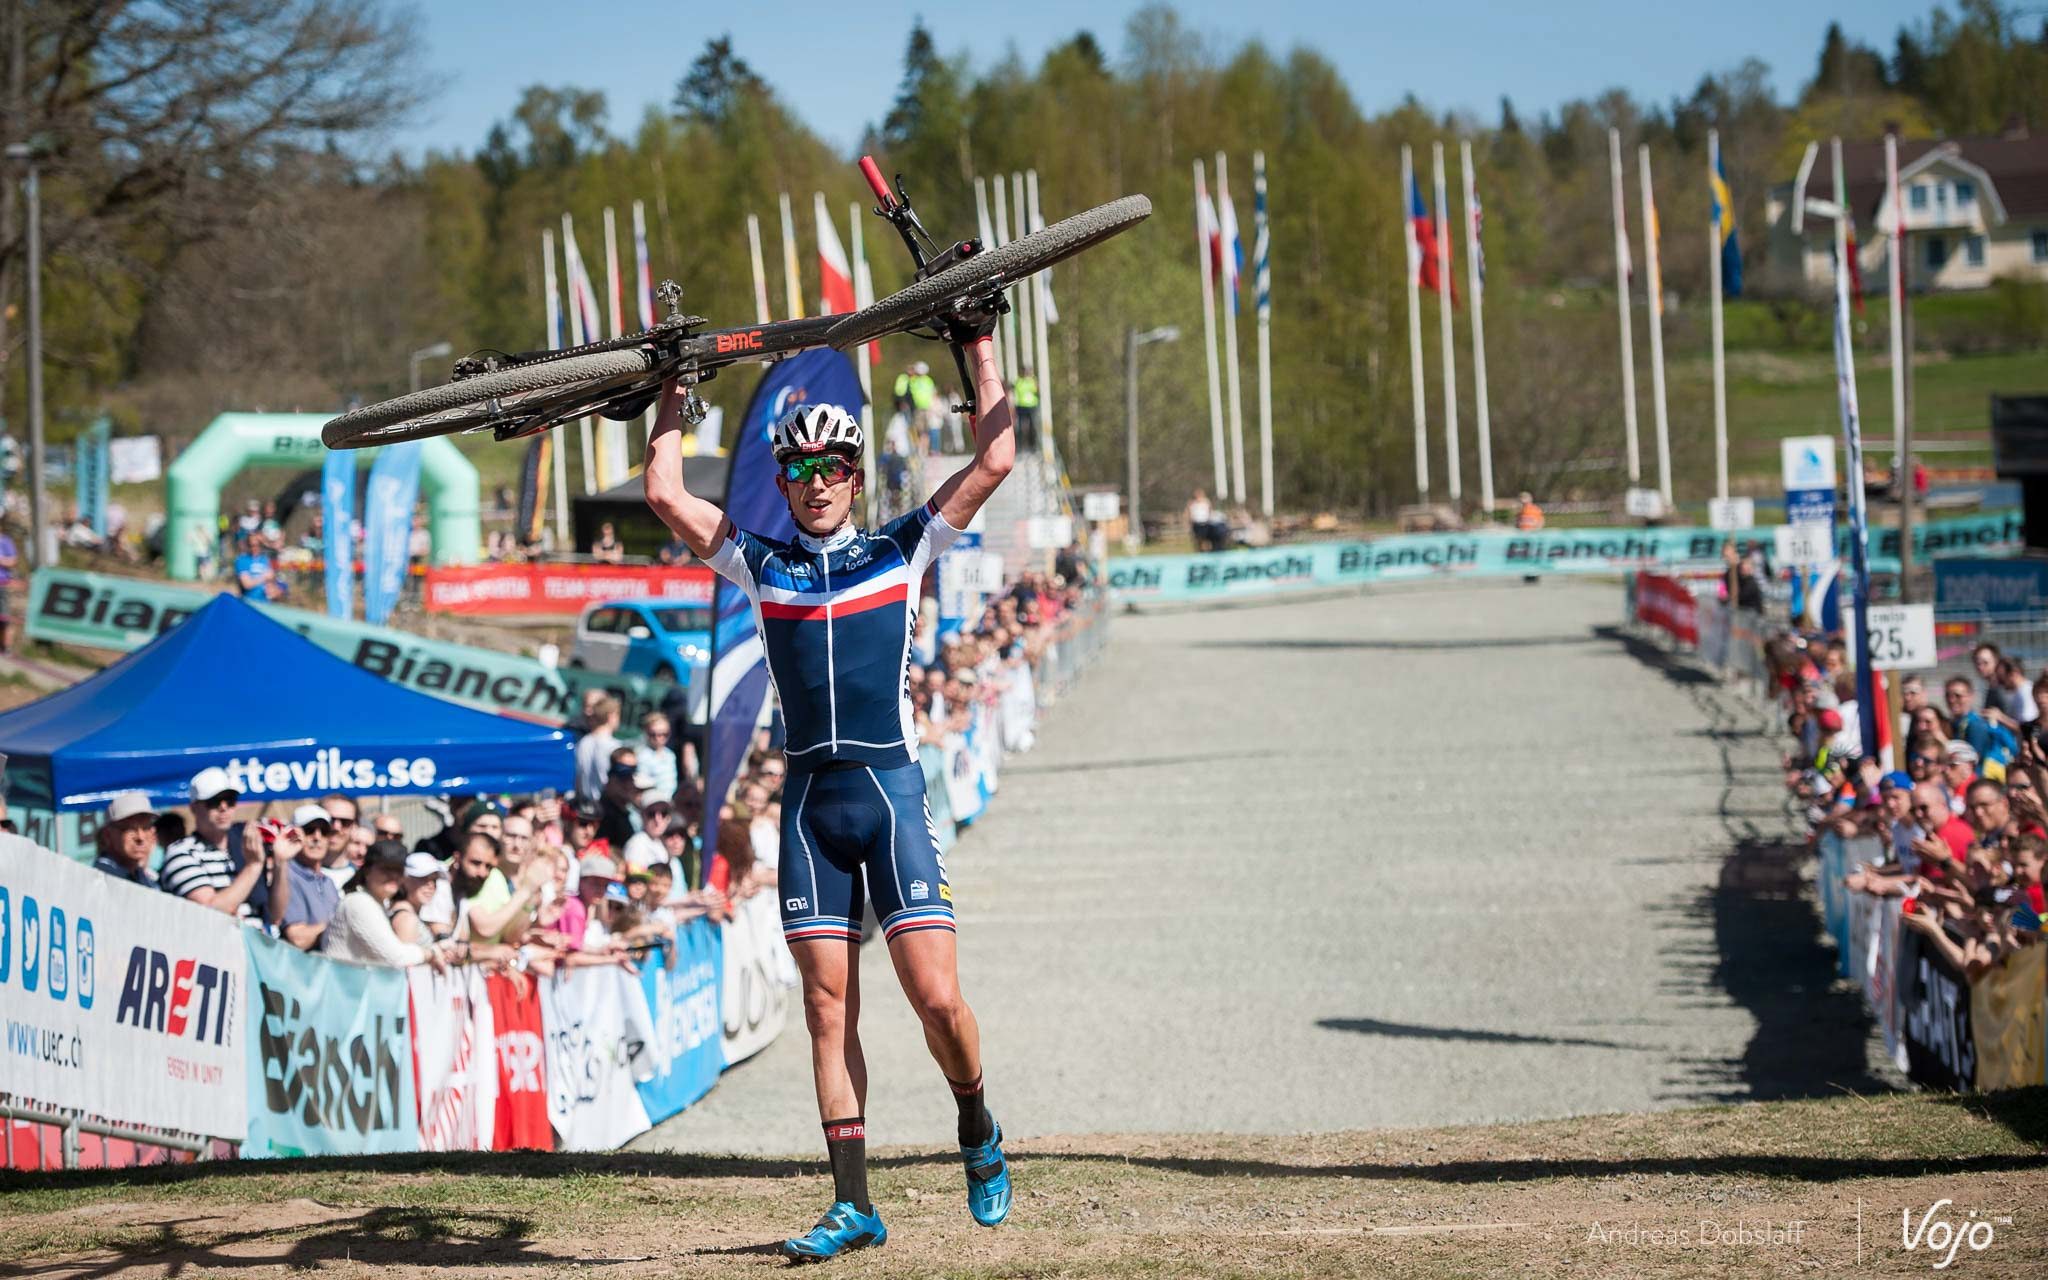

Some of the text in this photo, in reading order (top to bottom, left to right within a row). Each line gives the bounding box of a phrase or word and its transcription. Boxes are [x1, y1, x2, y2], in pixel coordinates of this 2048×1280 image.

[717, 330, 763, 353] BMC
[845, 553, 874, 572] LOOK
[1186, 554, 1312, 588] Bianchi
[1339, 542, 1478, 573] Bianchi
[116, 945, 229, 1046] ARETI
[6, 1018, 83, 1069] www.uec.ch
[260, 982, 405, 1136] Bianchi
